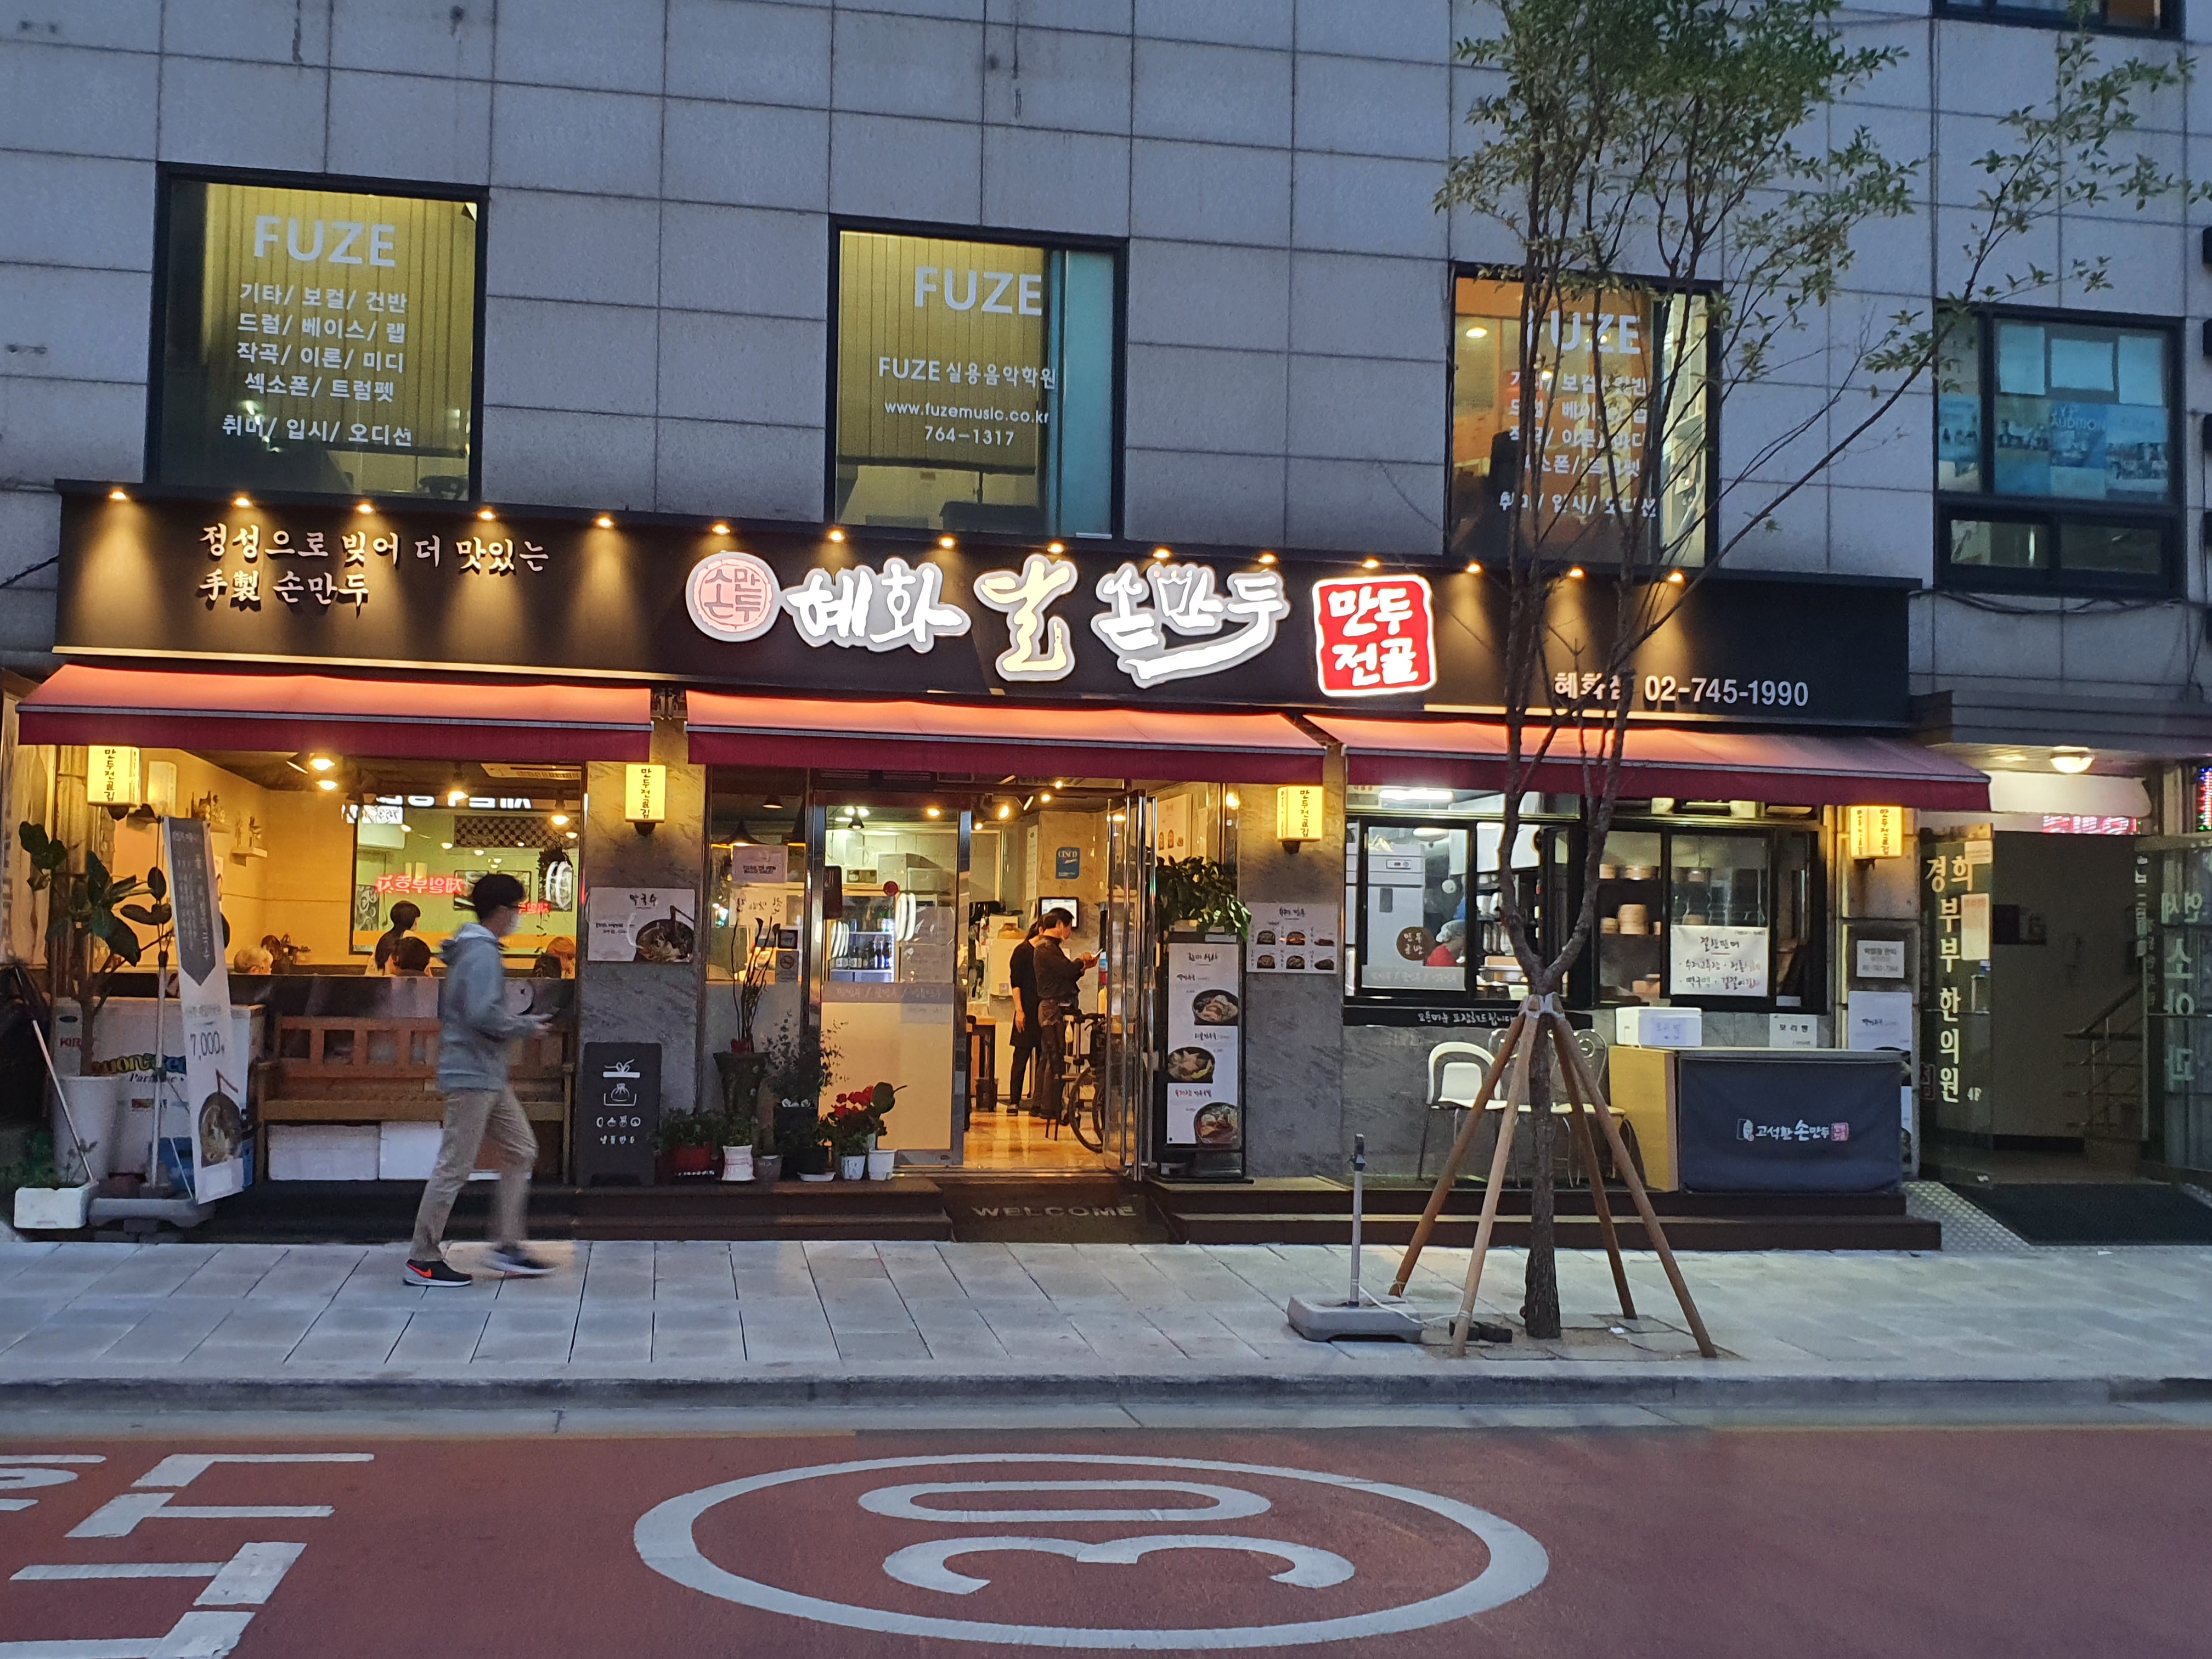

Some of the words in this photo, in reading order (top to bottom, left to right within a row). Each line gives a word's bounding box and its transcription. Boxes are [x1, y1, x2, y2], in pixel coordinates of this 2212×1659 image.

[254, 215, 396, 267] FUZE
[239, 284, 294, 305] 기타/
[366, 291, 408, 313] 건반
[915, 266, 1042, 317] FUZE
[238, 313, 293, 336] 드럼/
[302, 317, 377, 342] 베이스/
[238, 342, 292, 365] 작곡/
[301, 347, 354, 370] 이론/
[363, 352, 405, 373] 미디
[879, 357, 940, 382] FUZE
[946, 362, 1057, 390] 실용음악학원
[244, 373, 322, 398] 섹소폰/
[329, 379, 394, 403] 트럼펫
[885, 400, 1049, 425] www.fuzemusic.co.kr
[286, 419, 340, 443] 입시/
[348, 424, 413, 447] 오디션
[924, 426, 1014, 447] 764-1317
[200, 523, 329, 560] 정성으로
[342, 531, 401, 566] 빚어
[415, 535, 441, 567] 더
[456, 537, 549, 572] 맛있는
[200, 568, 261, 602] 手製
[273, 572, 370, 607] 손만두
[786, 563, 964, 644] 혜화
[1328, 586, 1413, 637] 만두
[1331, 637, 1419, 687] 전골
[1644, 675, 1808, 707] 02-745-1990
[1925, 855, 1973, 893] 경희
[970, 1205, 1137, 1217] WELCOME
[857, 1479, 1356, 1597] 30
